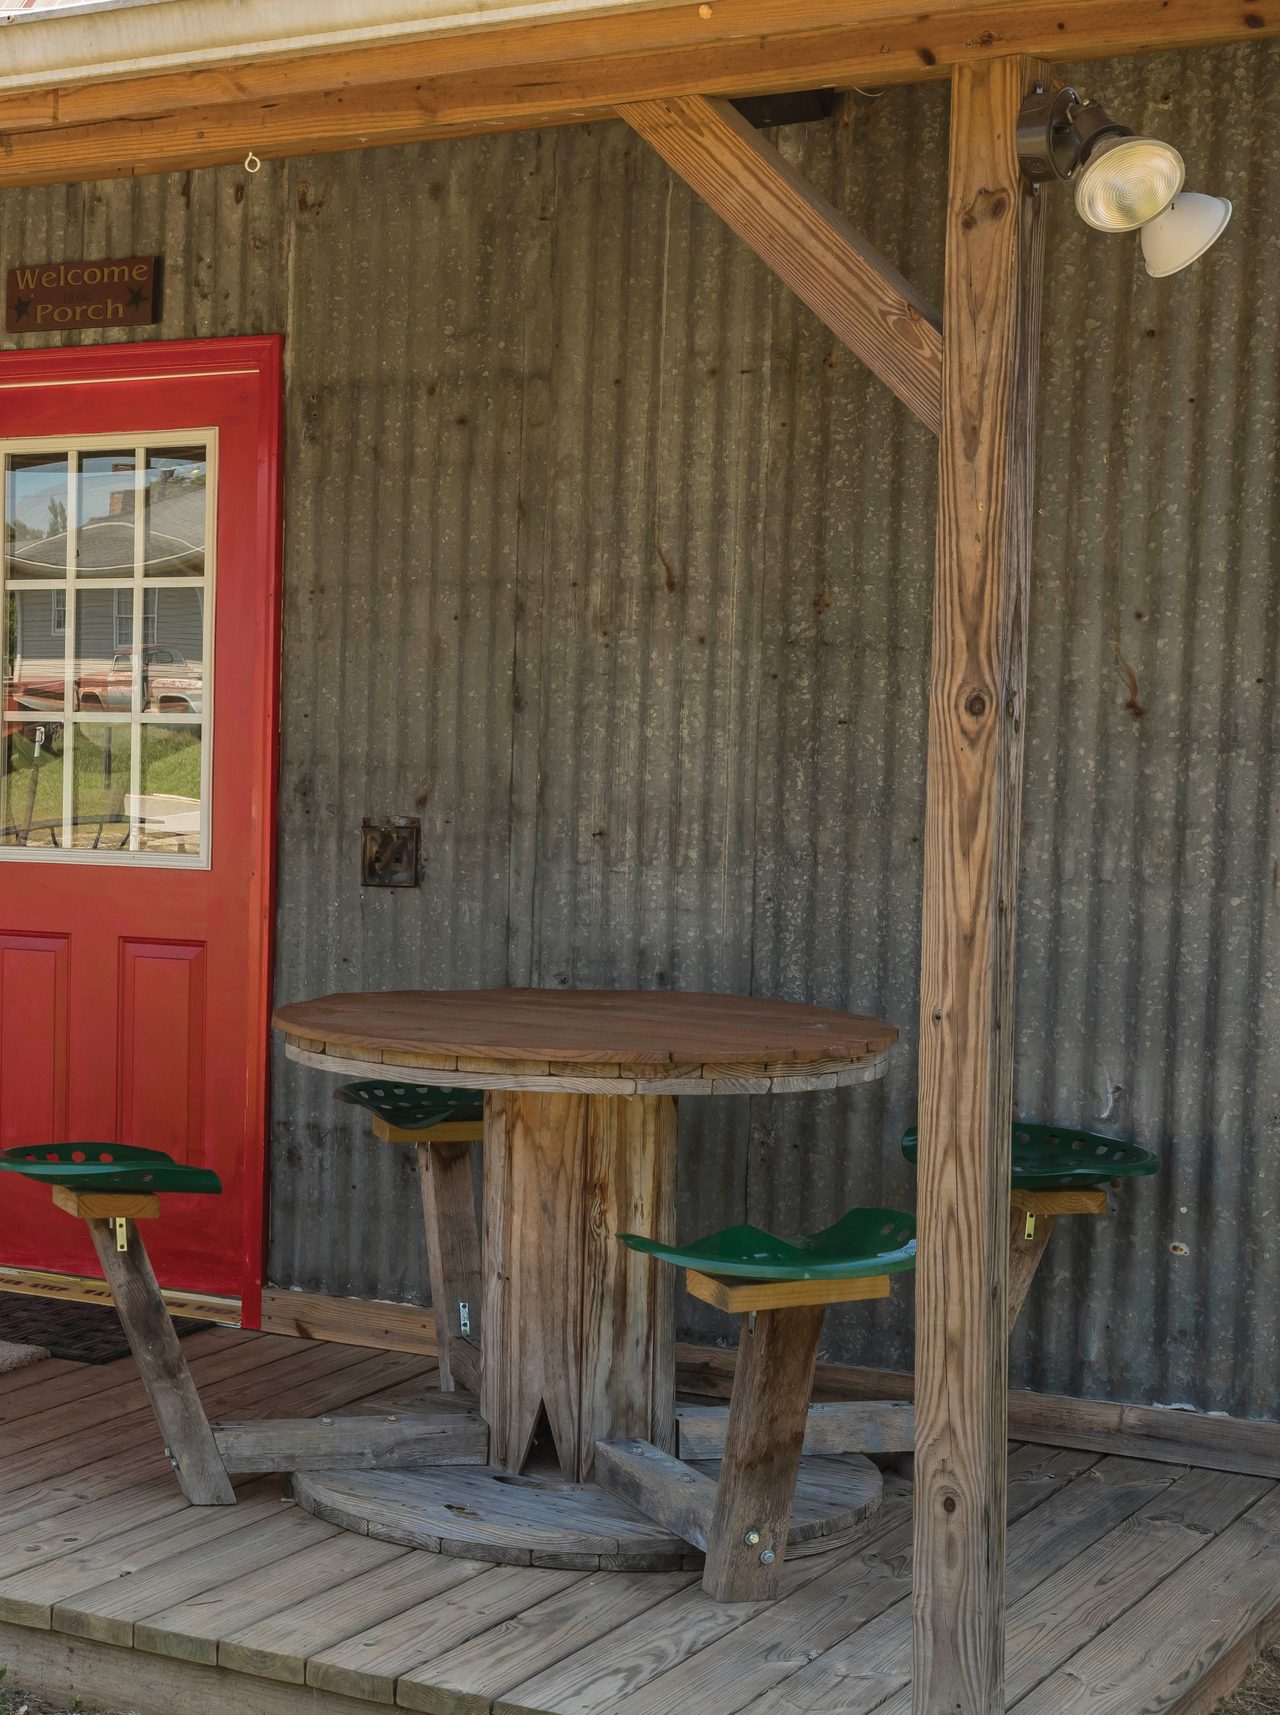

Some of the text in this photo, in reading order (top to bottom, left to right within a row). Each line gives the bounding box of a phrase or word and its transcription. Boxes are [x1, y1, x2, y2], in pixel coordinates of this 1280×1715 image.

[15, 264, 148, 290] Welcome
[35, 298, 124, 325] Porch
[29, 1283, 69, 1292] STEP
